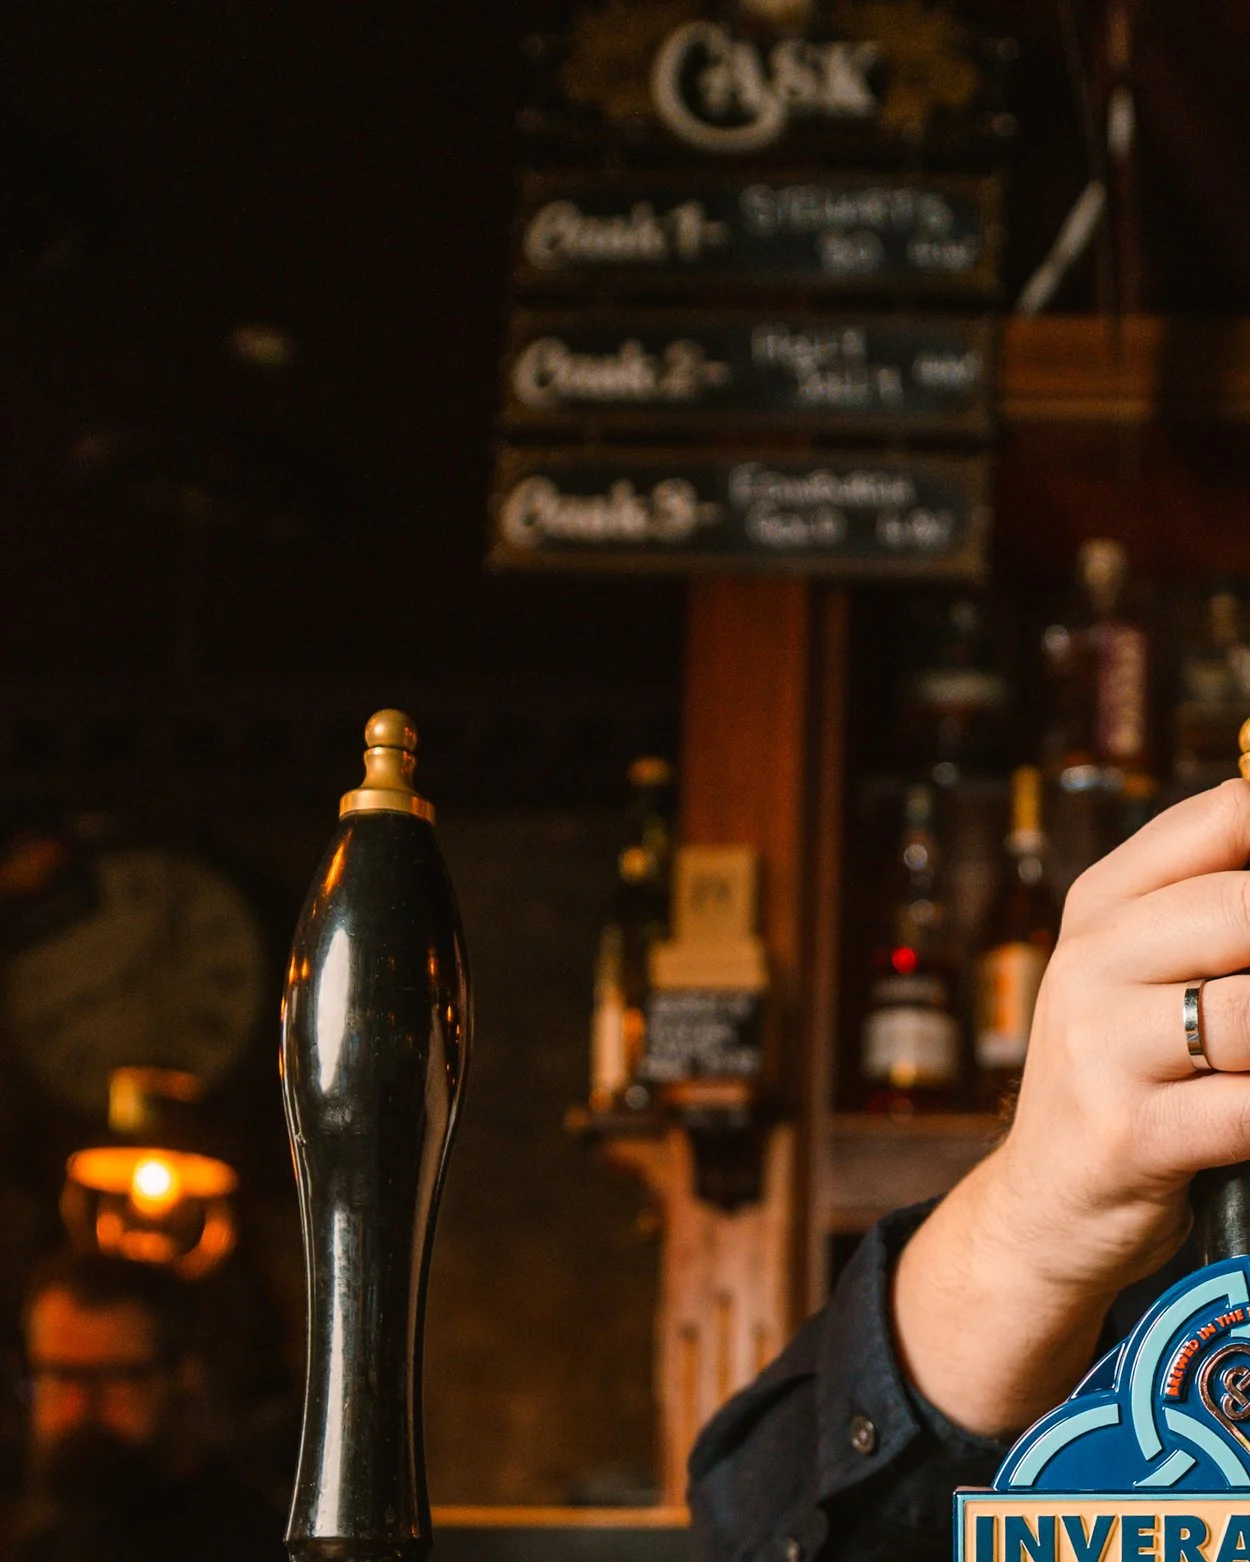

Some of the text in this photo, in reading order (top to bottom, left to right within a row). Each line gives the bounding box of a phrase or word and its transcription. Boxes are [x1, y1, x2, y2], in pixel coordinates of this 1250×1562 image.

[1166, 1339, 1199, 1396] BREWED
[1197, 1323, 1217, 1340] IN
[1215, 1306, 1244, 1328] THE
